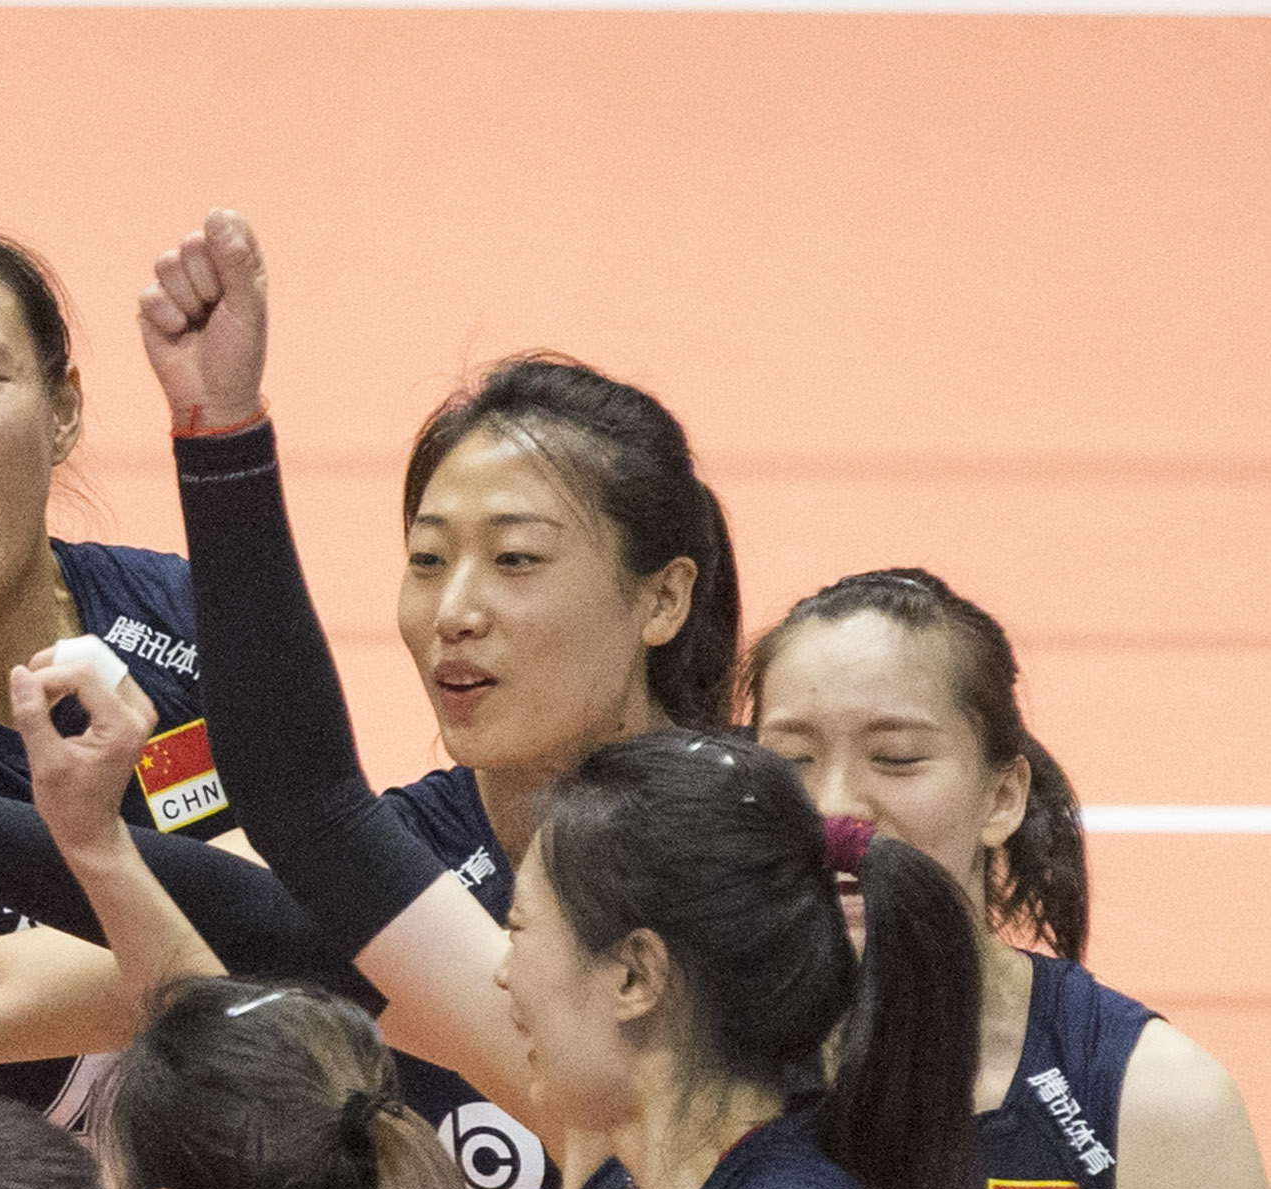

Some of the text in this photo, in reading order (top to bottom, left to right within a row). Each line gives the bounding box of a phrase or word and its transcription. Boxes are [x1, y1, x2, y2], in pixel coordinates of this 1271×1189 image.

[162, 781, 220, 820] CHN
[1026, 1066, 1117, 1176] 腾讯体育
